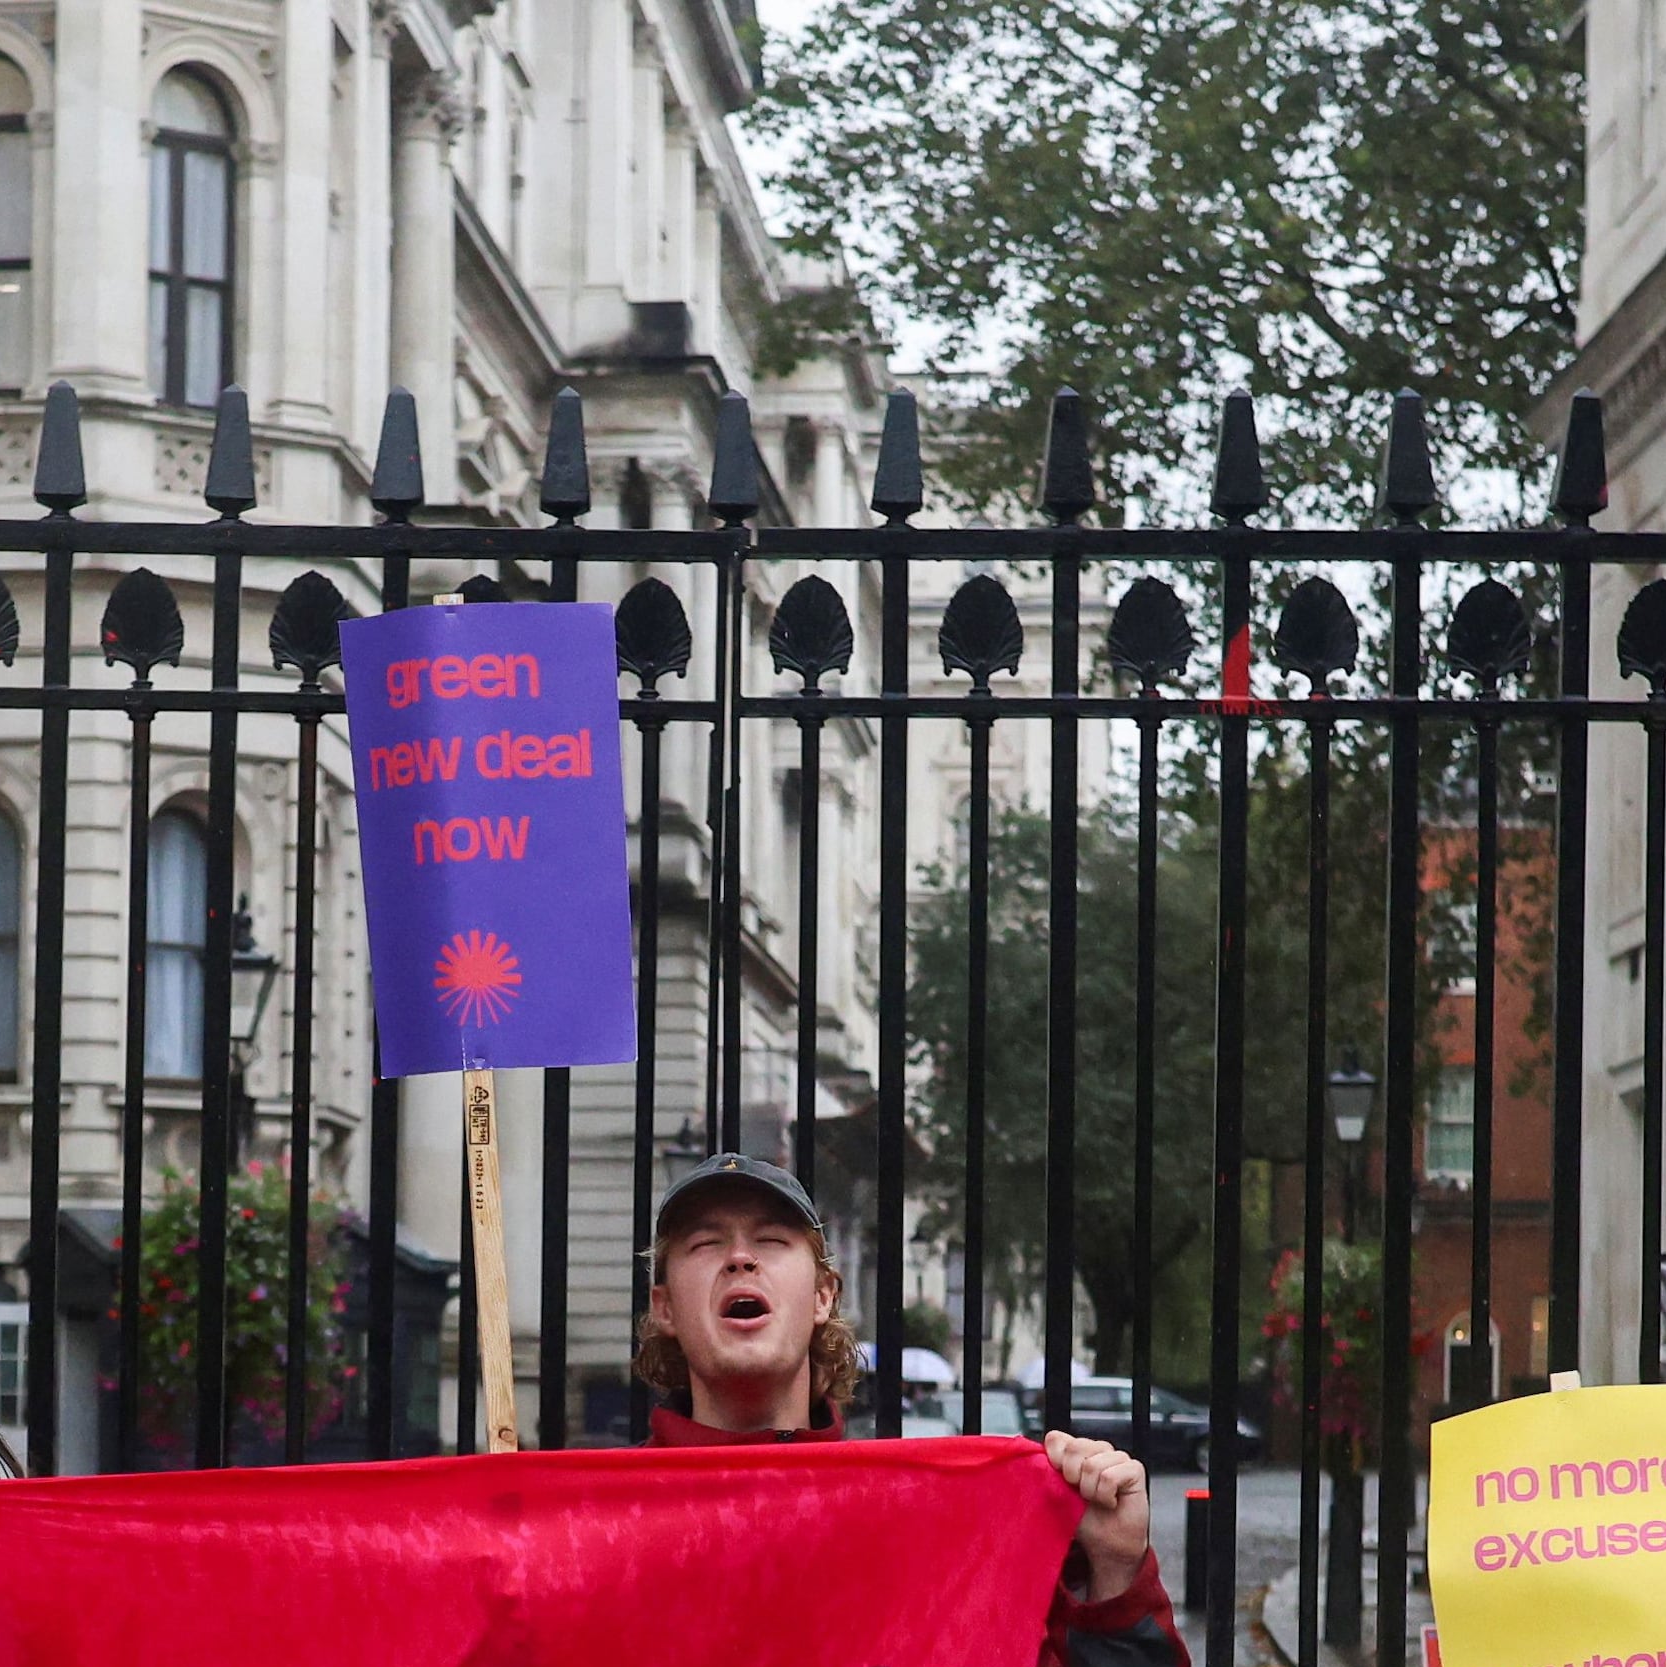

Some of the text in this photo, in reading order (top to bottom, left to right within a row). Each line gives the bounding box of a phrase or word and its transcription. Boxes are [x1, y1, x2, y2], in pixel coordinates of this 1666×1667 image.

[386, 654, 541, 709] green
[369, 728, 593, 791] new deal
[413, 816, 531, 865] now
[1476, 1466, 1541, 1506] no
